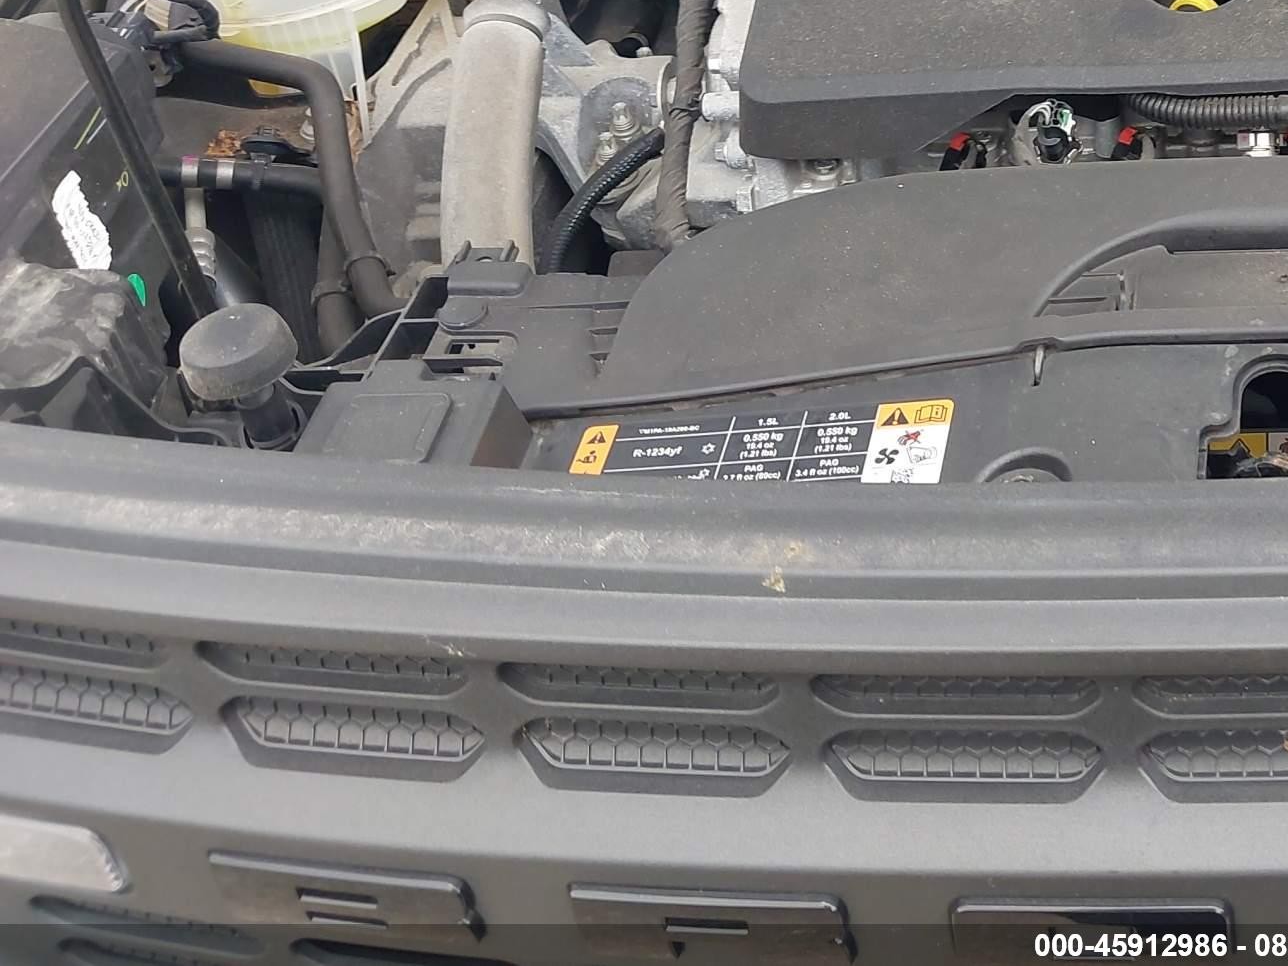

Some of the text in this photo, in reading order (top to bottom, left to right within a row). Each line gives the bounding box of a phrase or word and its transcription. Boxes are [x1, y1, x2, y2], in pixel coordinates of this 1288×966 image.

[828, 411, 851, 421] 2.0L
[758, 417, 779, 427] 1.5L
[817, 426, 858, 437] 0.550 kg
[743, 432, 784, 442] 0.550 kg
[633, 446, 682, 458] R-1234yf
[744, 464, 764, 472] PAG
[795, 469, 808, 477] 3.4
[828, 465, 860, 476] (100cc)
